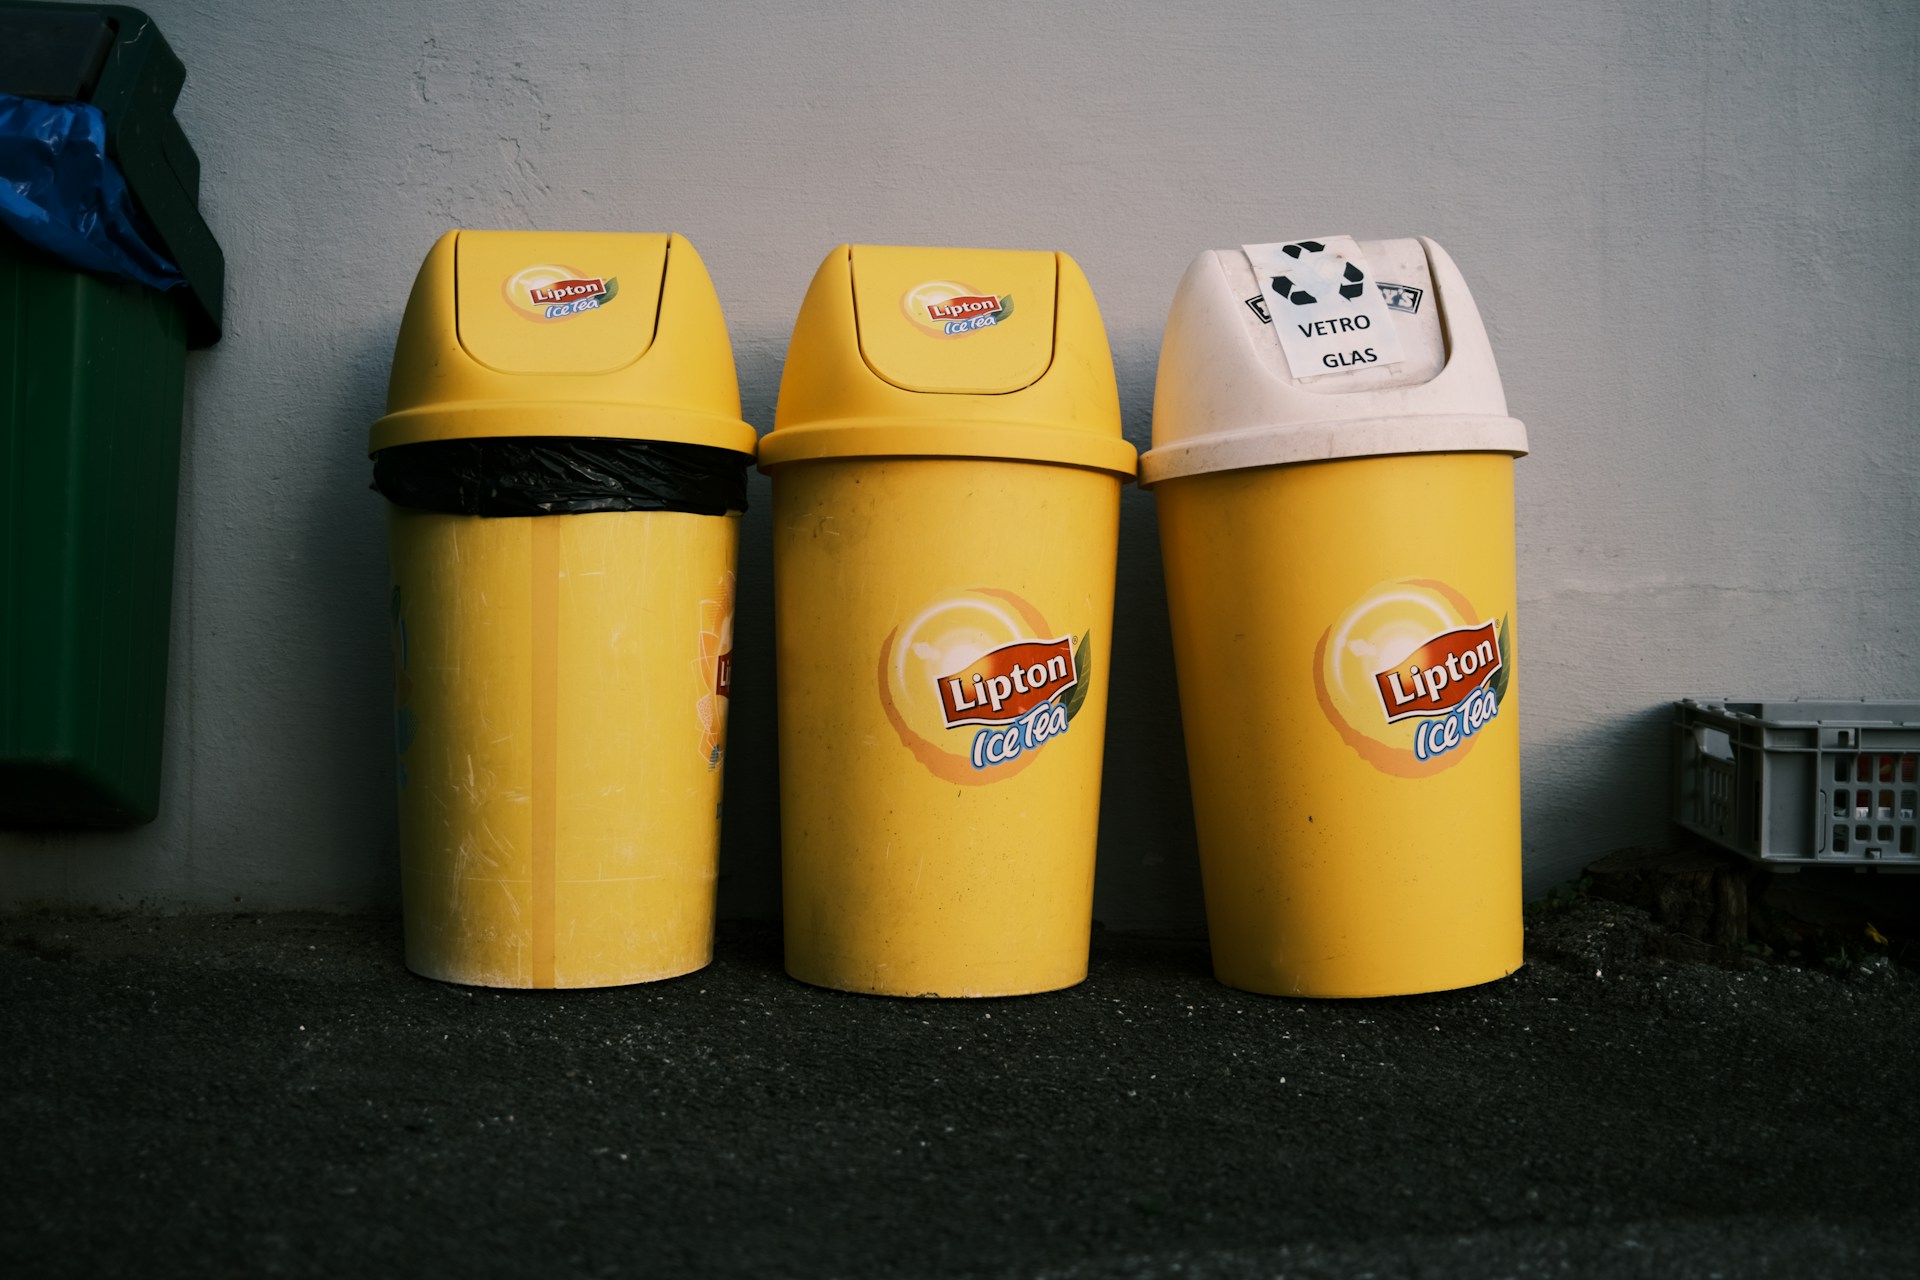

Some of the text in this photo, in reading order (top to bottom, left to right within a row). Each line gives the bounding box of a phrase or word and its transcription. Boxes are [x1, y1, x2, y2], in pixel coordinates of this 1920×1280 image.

[535, 282, 600, 302] Lipton
[546, 298, 600, 319] Ice Tea
[932, 299, 996, 318] Lipton
[945, 314, 997, 335] Ice Tea
[1298, 314, 1371, 338] VETRO
[1322, 347, 1378, 368] GLAS
[949, 653, 1069, 712] Lipton
[1387, 638, 1495, 706] Lipton
[1415, 688, 1498, 760] Ice Tea
[971, 702, 1067, 769] Ice Tea
